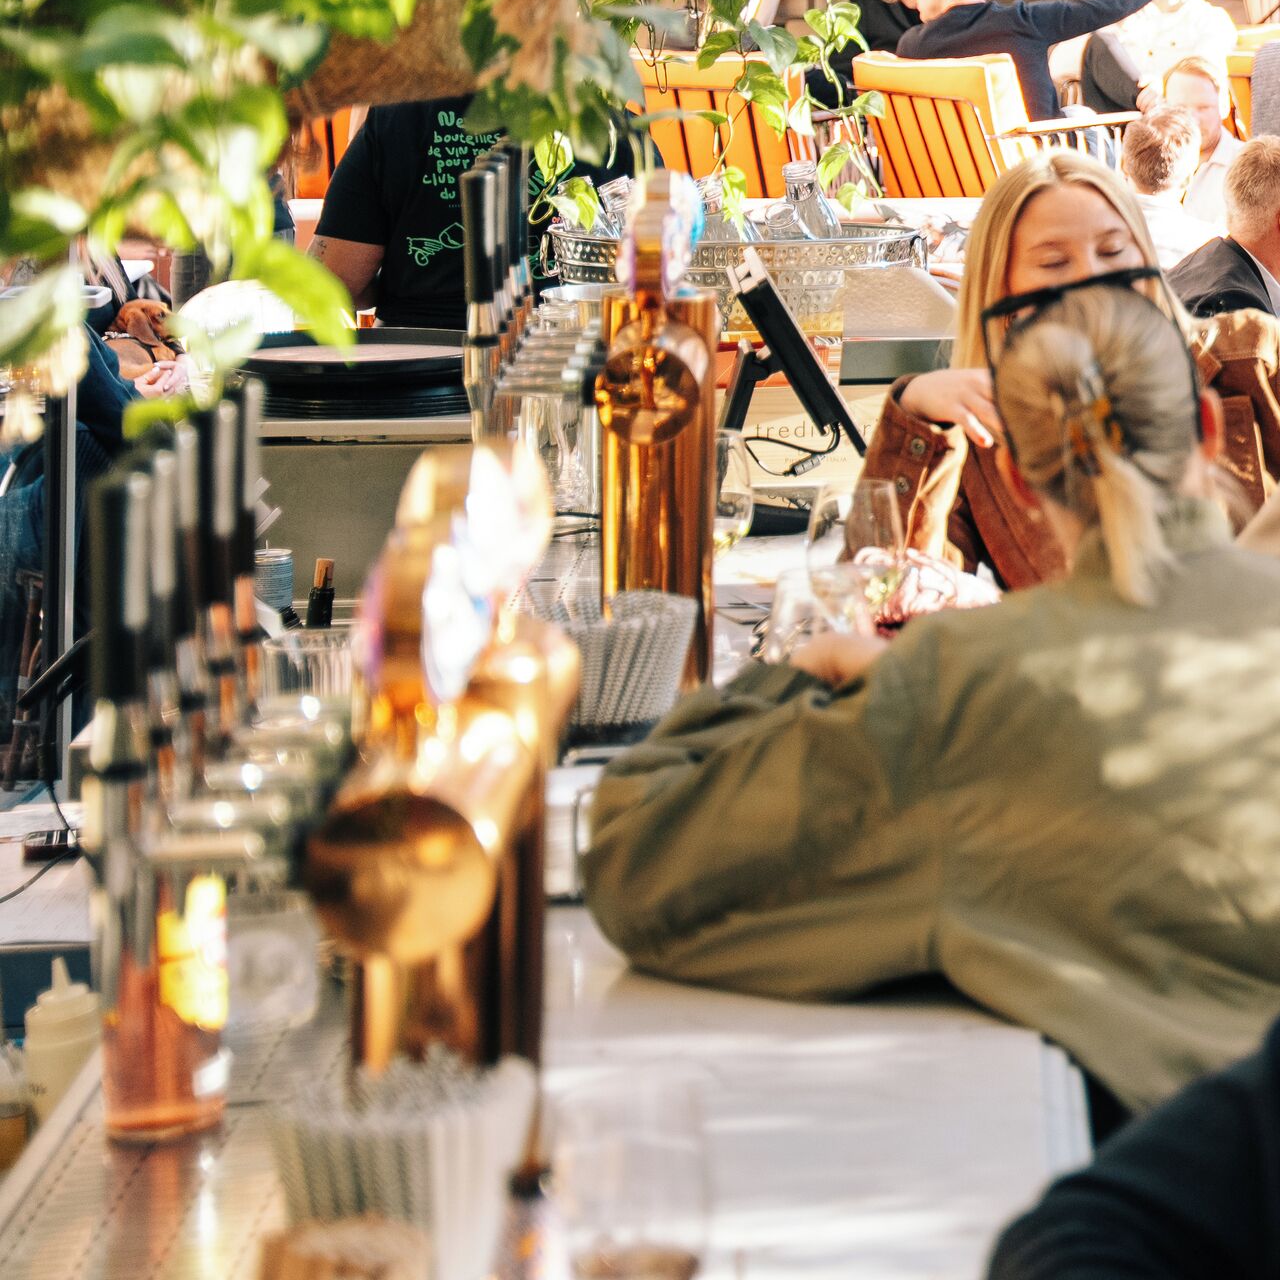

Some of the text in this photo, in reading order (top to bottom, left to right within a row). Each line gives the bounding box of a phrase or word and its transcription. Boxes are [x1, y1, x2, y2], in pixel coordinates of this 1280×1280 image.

[427, 146, 441, 157] de
[436, 158, 470, 173] pour
[422, 174, 455, 186] club
[440, 188, 456, 199] du
